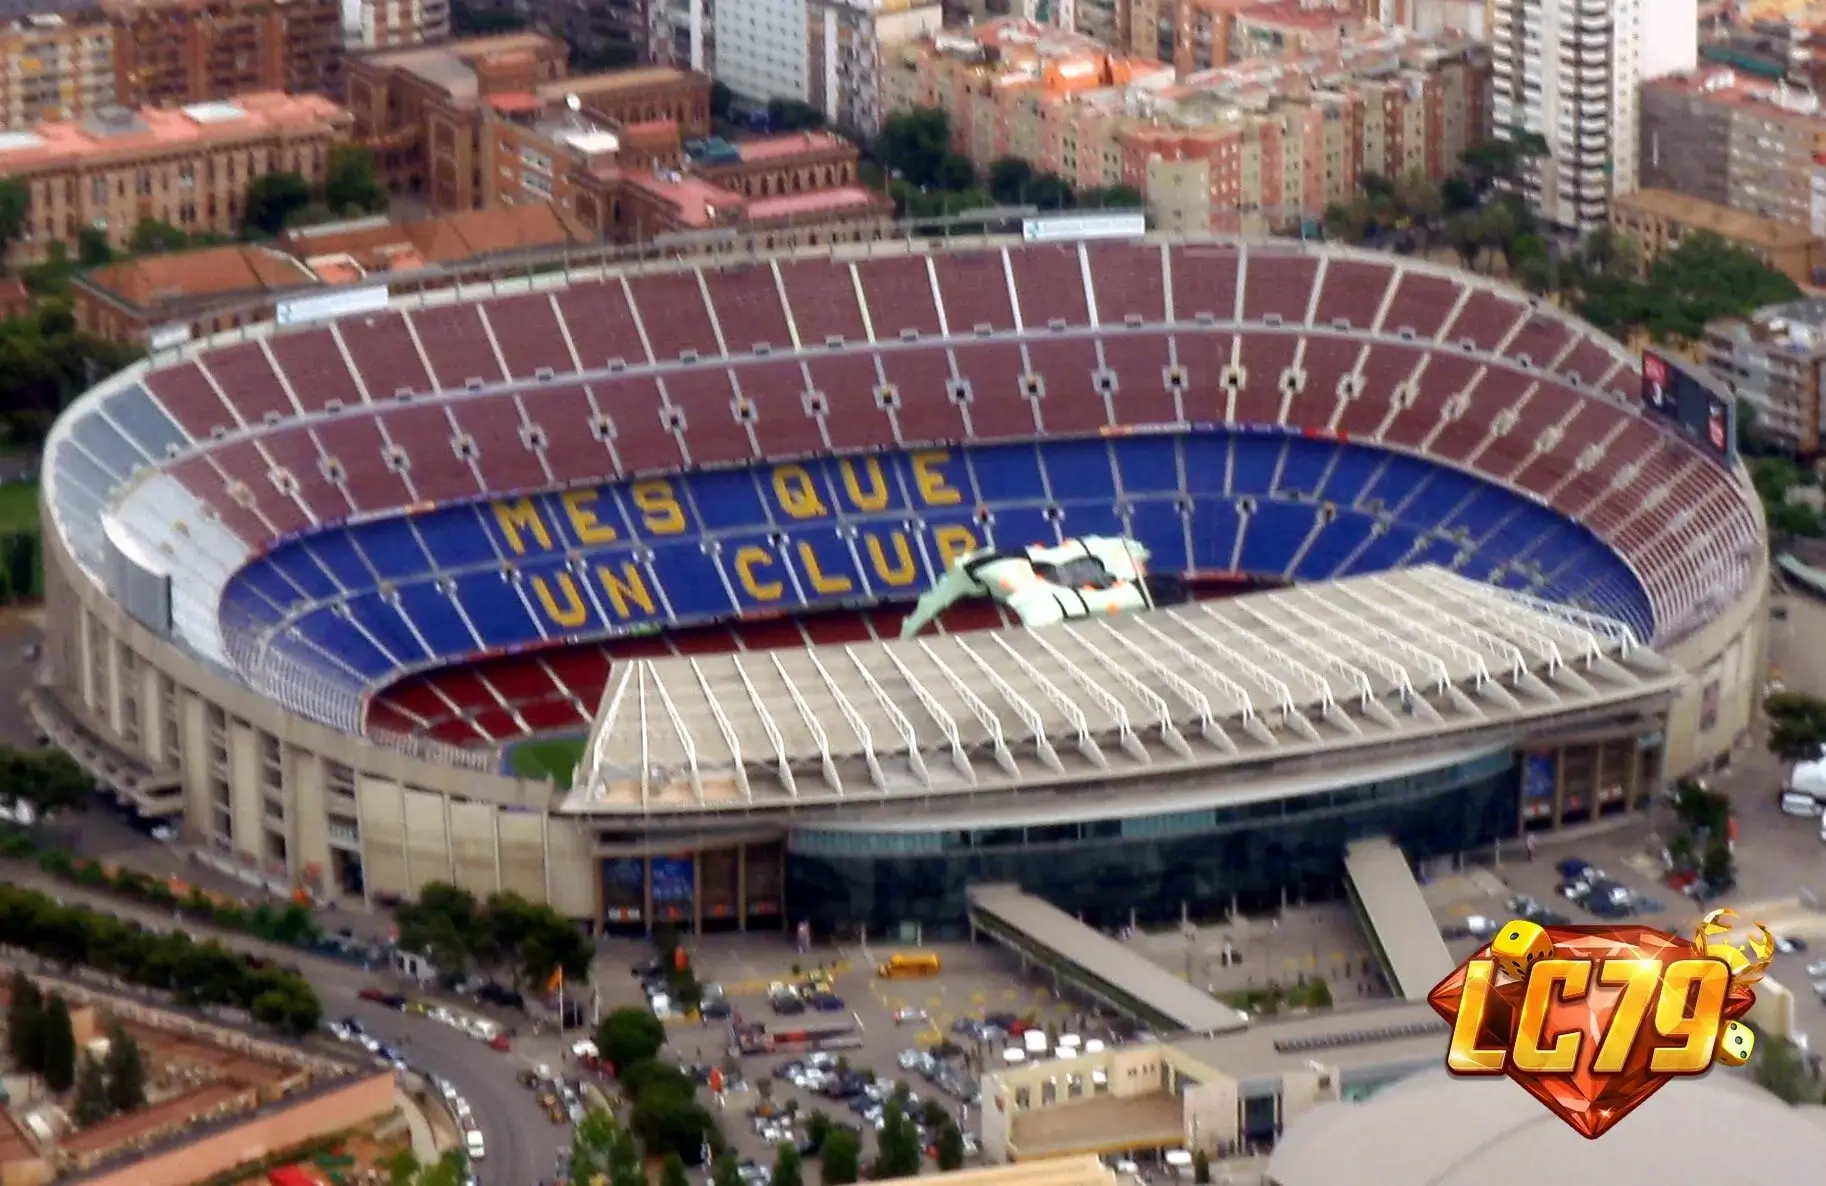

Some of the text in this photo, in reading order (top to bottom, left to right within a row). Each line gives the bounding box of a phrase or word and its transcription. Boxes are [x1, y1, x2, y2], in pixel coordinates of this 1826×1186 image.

[493, 451, 961, 555] MES QUE
[531, 561, 656, 627] UN
